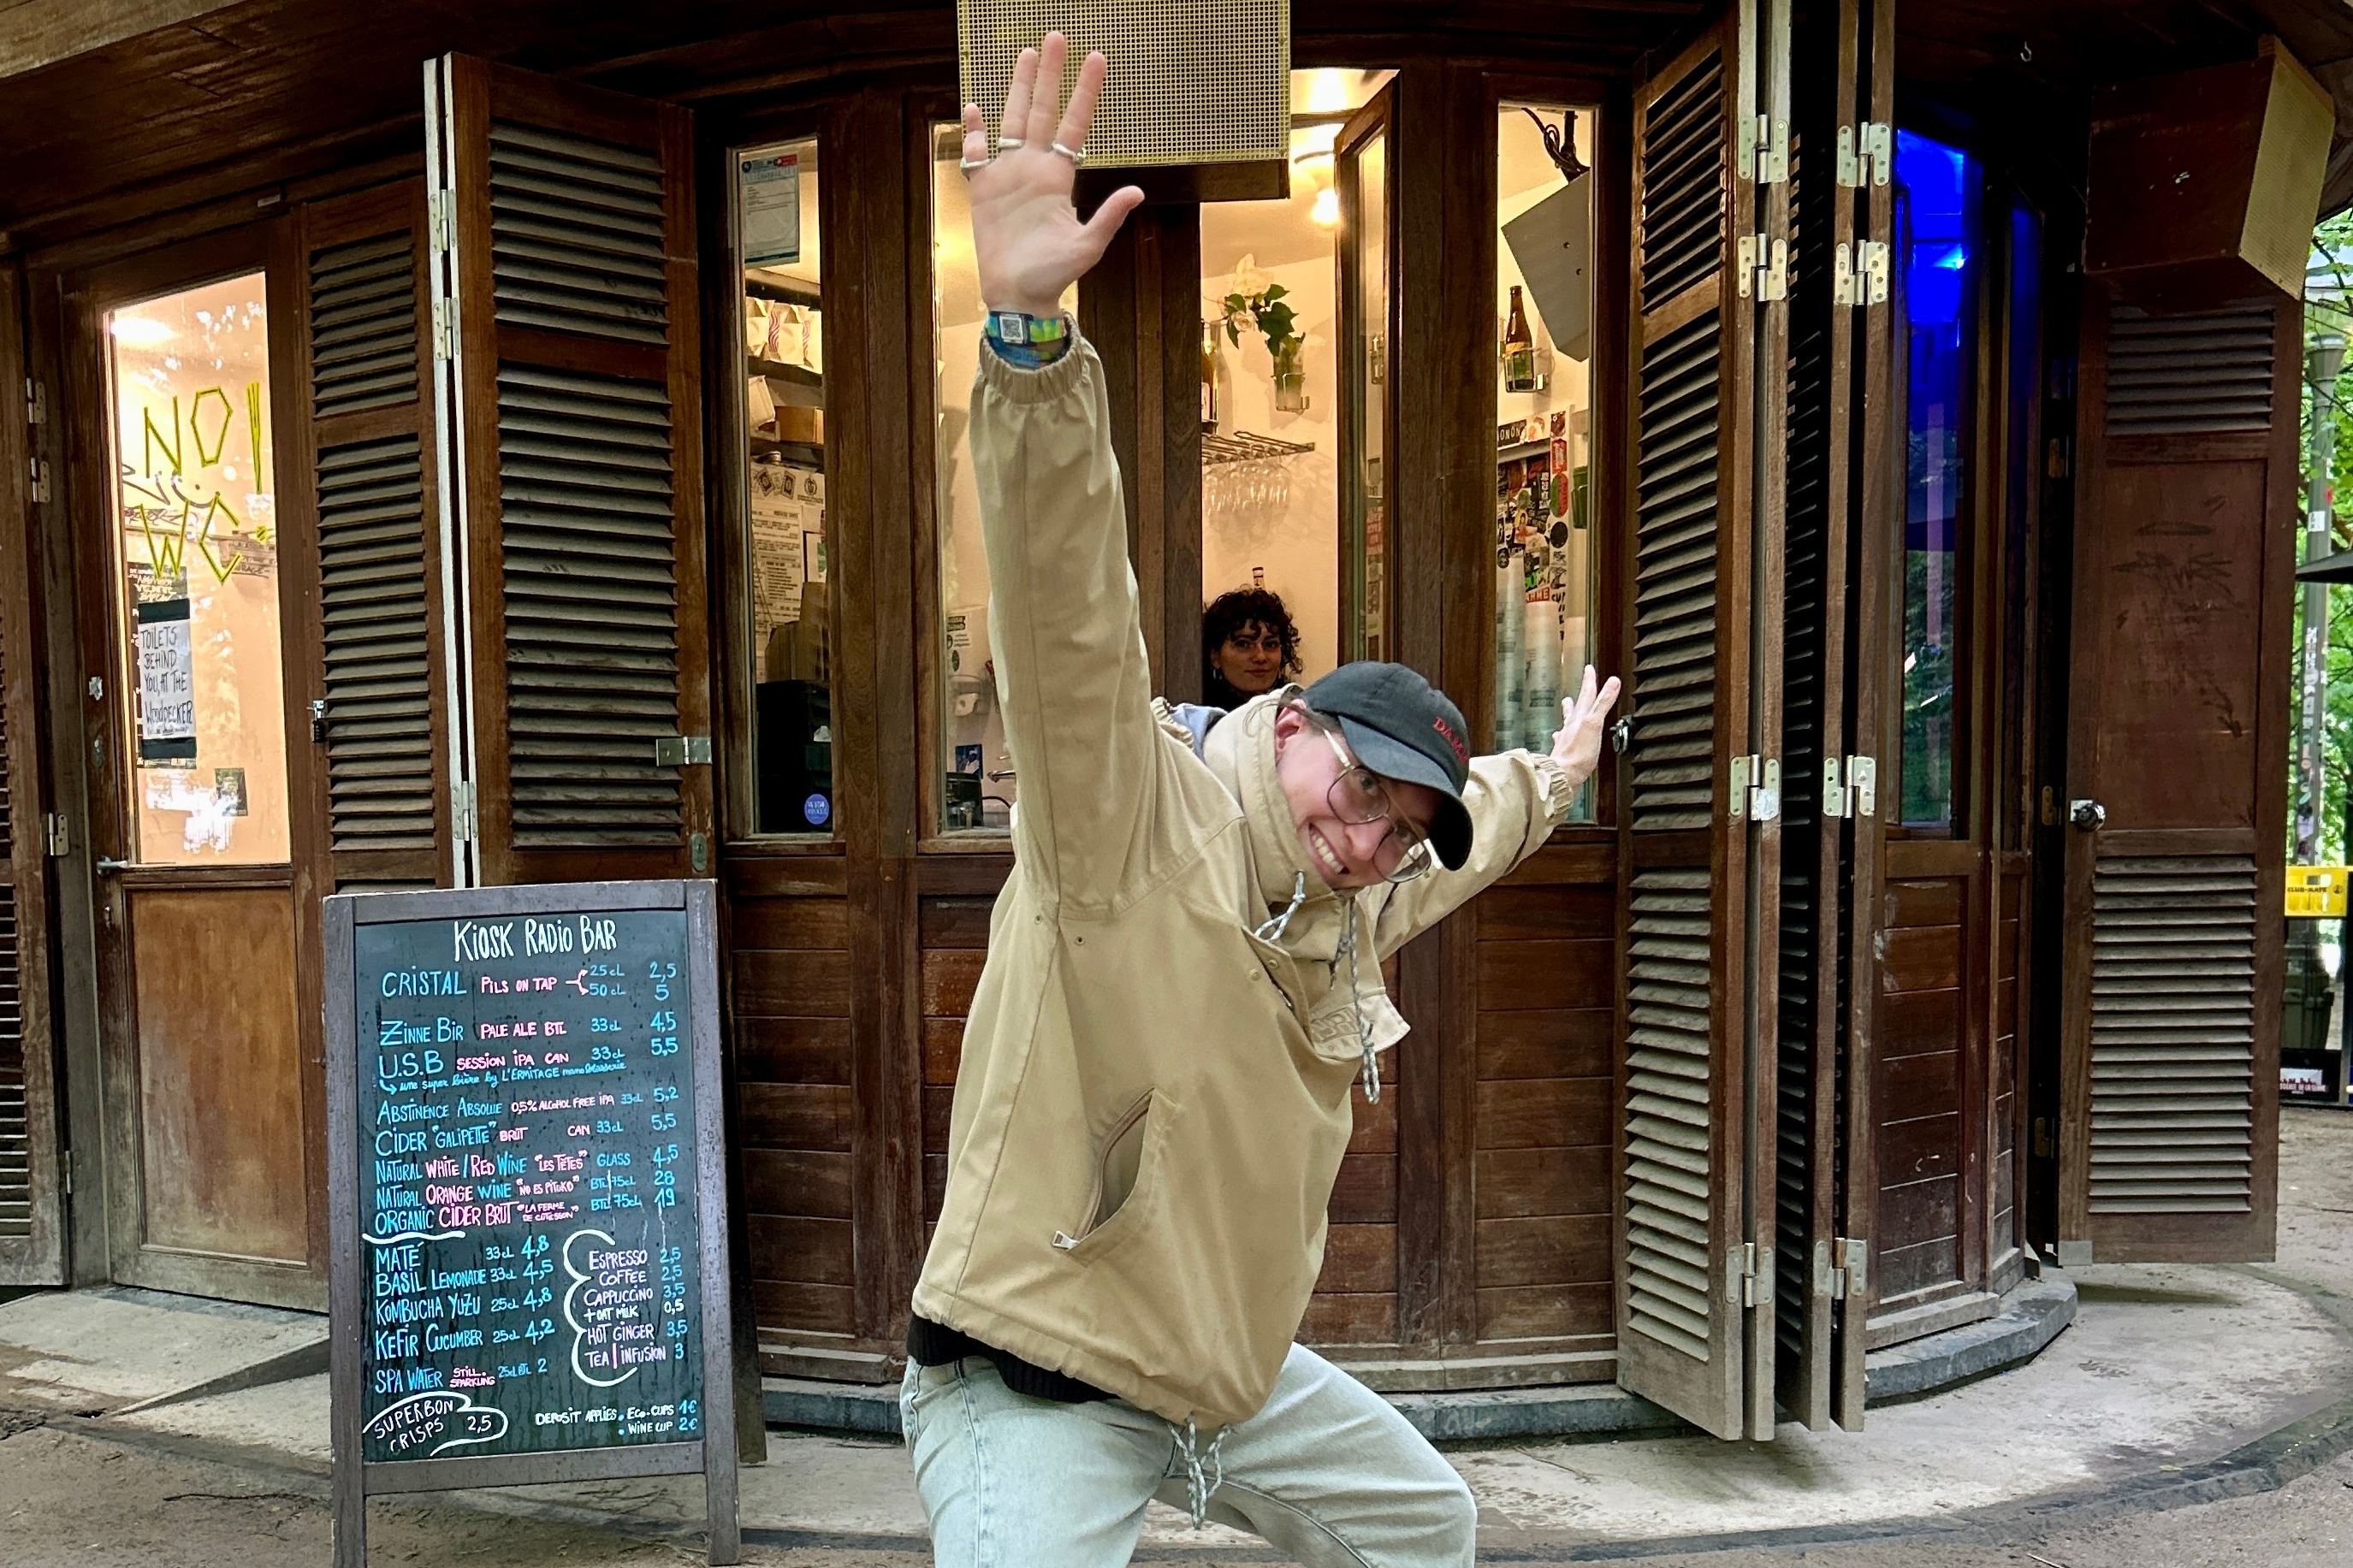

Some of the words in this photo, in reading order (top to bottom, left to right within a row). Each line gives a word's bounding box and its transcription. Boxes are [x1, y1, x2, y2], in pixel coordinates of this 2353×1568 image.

[143, 382, 268, 544] NO!
[139, 492, 243, 585] WC
[171, 669, 187, 693] THE
[579, 914, 618, 955] BAR
[515, 979, 529, 992] ON
[531, 976, 559, 992] TAP
[649, 960, 678, 984] 2,5
[654, 983, 670, 1002] 5
[480, 1023, 509, 1040] PALE
[513, 1021, 537, 1037] ALE
[543, 1021, 567, 1037] BTL
[649, 1010, 677, 1033] 4,5
[544, 1052, 570, 1065] CAN
[650, 1036, 679, 1056] 5,5
[422, 1080, 449, 1094] super
[484, 1070, 500, 1088] by
[510, 1099, 538, 1115] 0,5%
[572, 1095, 596, 1109] FREE
[653, 1086, 679, 1103] 5,2
[498, 1126, 529, 1142] BRUT
[567, 1124, 590, 1137] CAN
[650, 1112, 678, 1132] 5,5
[375, 1158, 424, 1185] NATURAL
[470, 1154, 495, 1178] RED
[596, 1152, 631, 1168] GLASS
[652, 1143, 679, 1169] 4,5
[375, 1185, 423, 1210] NATURAL
[425, 1183, 474, 1205] ORANGE
[533, 1183, 544, 1195] ES
[654, 1169, 676, 1186] 28
[485, 1200, 520, 1227] BRUT
[537, 1201, 566, 1213] FERME
[653, 1187, 676, 1209] 19
[522, 1214, 533, 1222] DE
[520, 1234, 550, 1260] 4,8
[588, 1249, 648, 1271] ESPRESSO
[659, 1246, 682, 1264] 2,5
[430, 1268, 487, 1291] LEMONADE
[522, 1258, 554, 1286] 4,5
[598, 1268, 648, 1287] COFFEE
[661, 1264, 683, 1281] 2,5
[447, 1292, 482, 1320] YUZU
[522, 1287, 553, 1312] 4,8
[662, 1282, 686, 1299] 3,5
[663, 1298, 685, 1316] 0,5
[425, 1322, 483, 1352] CUCUMBER
[524, 1317, 556, 1346] 4,2
[587, 1322, 613, 1346] HOT
[666, 1318, 688, 1339] 3,5
[584, 1349, 610, 1369] TEA
[673, 1341, 685, 1360] 3
[375, 1368, 404, 1394] SPA
[407, 1365, 444, 1392] WATER
[536, 1357, 548, 1374] 2
[373, 1399, 454, 1441] SUPERBON
[678, 1399, 698, 1415] 1€
[466, 1413, 493, 1435] 2,5
[655, 1420, 674, 1434] CUP
[678, 1417, 699, 1432] 2€
